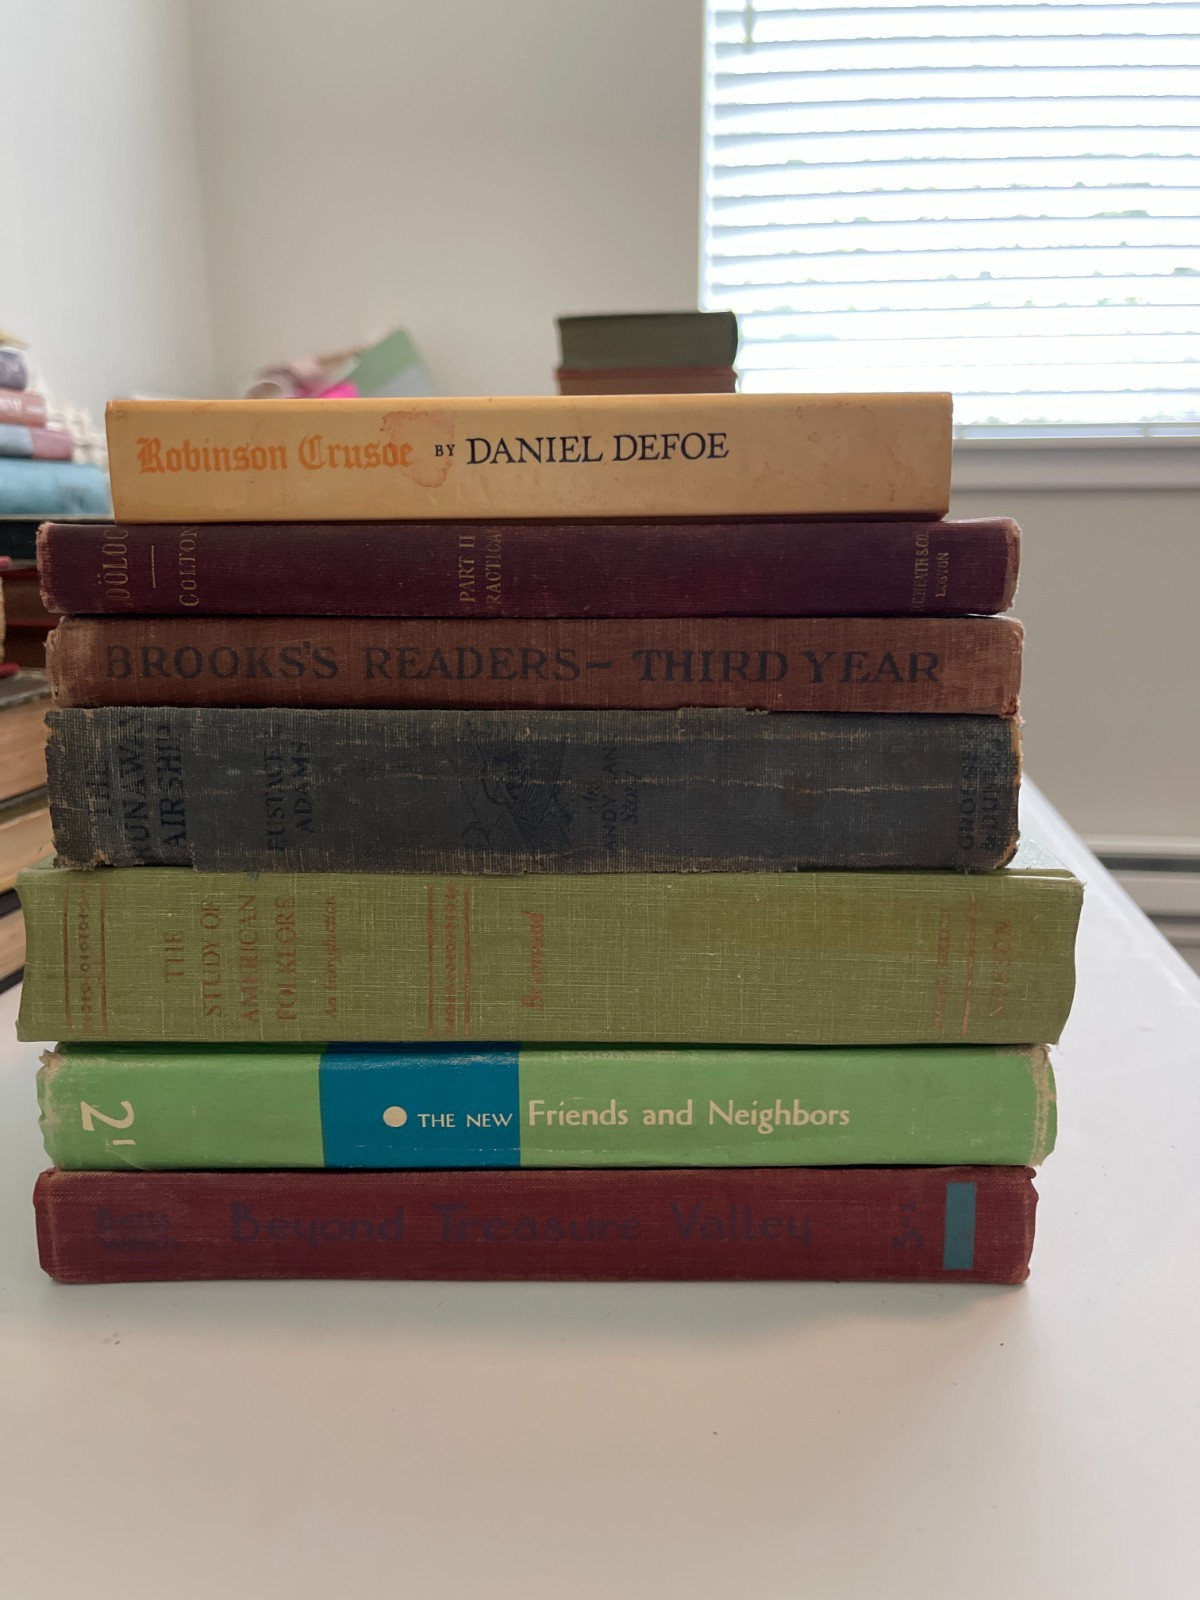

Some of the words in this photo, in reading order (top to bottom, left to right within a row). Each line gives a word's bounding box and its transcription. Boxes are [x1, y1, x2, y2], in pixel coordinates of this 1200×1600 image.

[136, 436, 288, 474] Robinson
[298, 434, 413, 470] Crusoe
[434, 443, 456, 457] BY
[466, 436, 603, 465] DANIEL
[612, 432, 730, 462] DEFOE
[459, 535, 475, 548] II
[459, 556, 475, 602] PART
[105, 641, 340, 680] BROOKS'S
[632, 649, 789, 683] THIRD
[803, 651, 940, 684] YEAR
[201, 900, 220, 931] OF
[164, 931, 185, 984] THE
[202, 942, 221, 1016] STUDY
[238, 895, 258, 1022] AMERICAN
[275, 896, 297, 1020] FOLKLORE
[417, 1113, 456, 1128] THE
[466, 1113, 514, 1128] NEW
[528, 1100, 628, 1126] Friends
[642, 1099, 693, 1125] and
[708, 1099, 850, 1134] Neighbors
[231, 1201, 405, 1247] Beyond
[430, 1203, 643, 1243] Treasure
[670, 1202, 812, 1247] Valley
